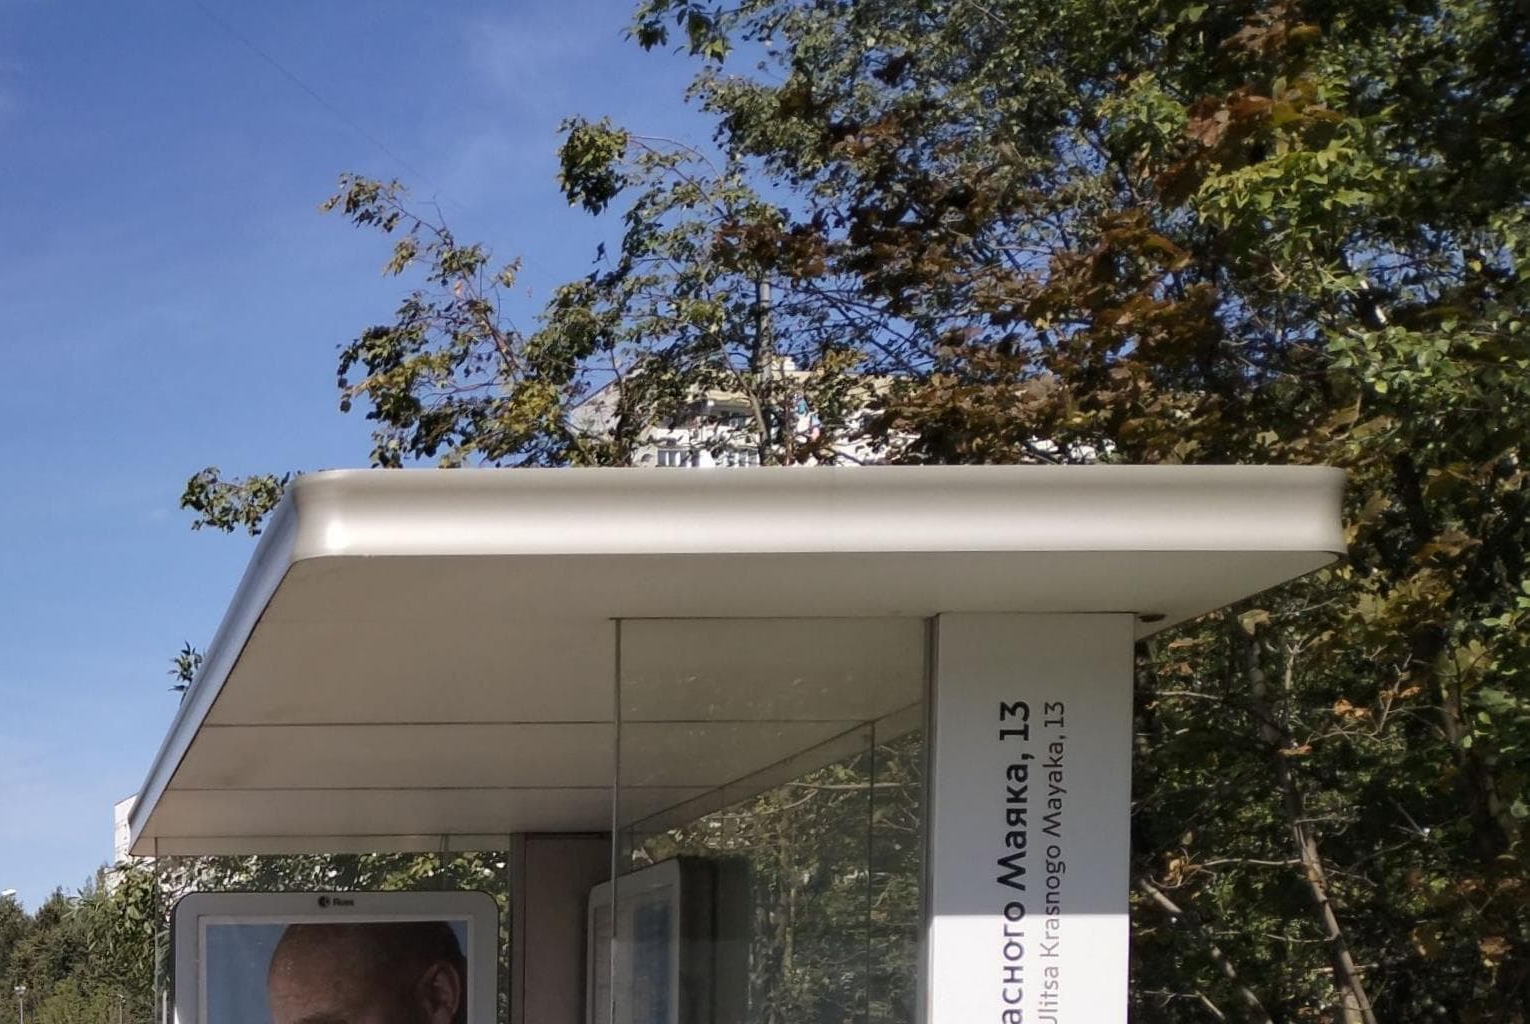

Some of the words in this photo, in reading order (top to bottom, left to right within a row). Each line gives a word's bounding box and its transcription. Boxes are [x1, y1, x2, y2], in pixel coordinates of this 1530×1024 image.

[999, 701, 1030, 741] 13
[1044, 701, 1065, 728] 13
[996, 753, 1035, 891] Маяка,
[1042, 735, 1068, 838] Mayaka,
[1039, 845, 1066, 957] Krasnogo
